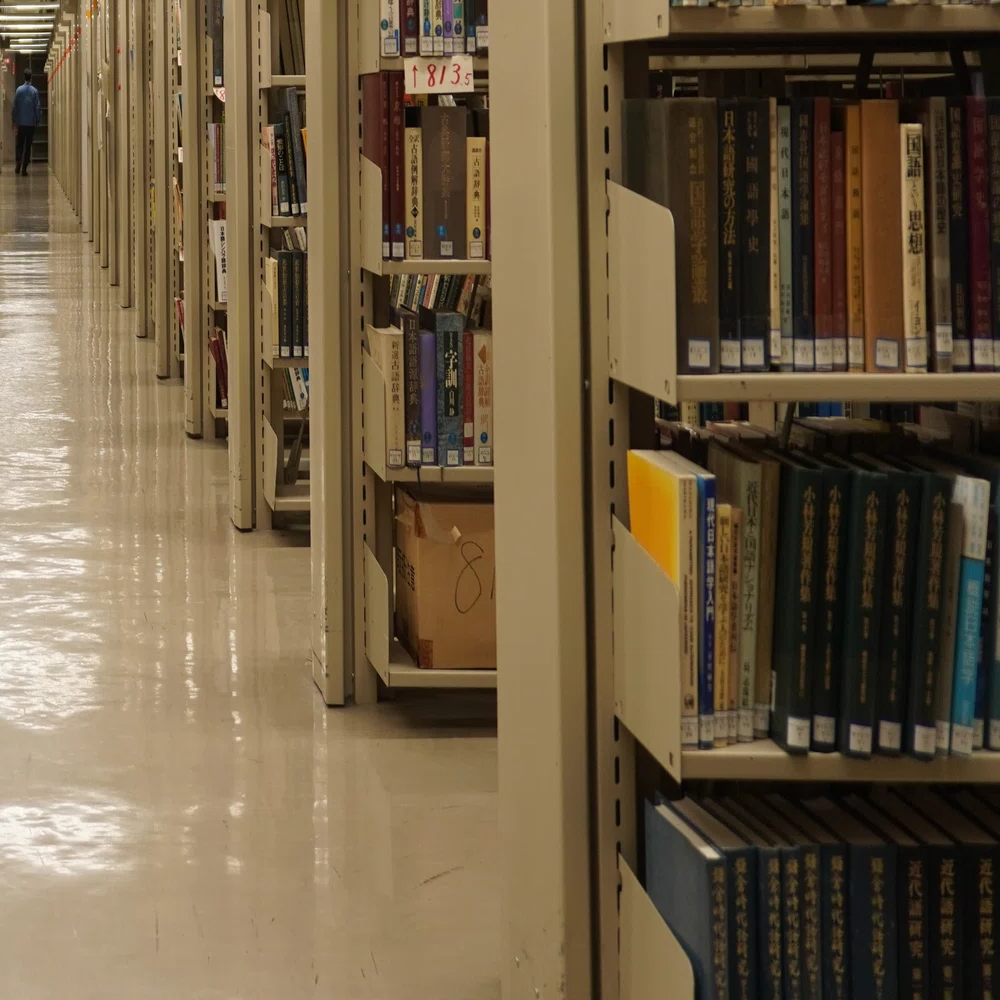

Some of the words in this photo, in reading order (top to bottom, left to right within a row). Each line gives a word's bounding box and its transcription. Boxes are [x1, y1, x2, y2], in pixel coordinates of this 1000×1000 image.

[722, 110, 737, 246] 日本語研究の方法
[780, 125, 790, 221] 現代日本語
[444, 349, 457, 389] 字訓
[908, 860, 923, 958] 近代語研究
[940, 858, 955, 956] 近代語研究
[979, 858, 994, 956] 近代語研究
